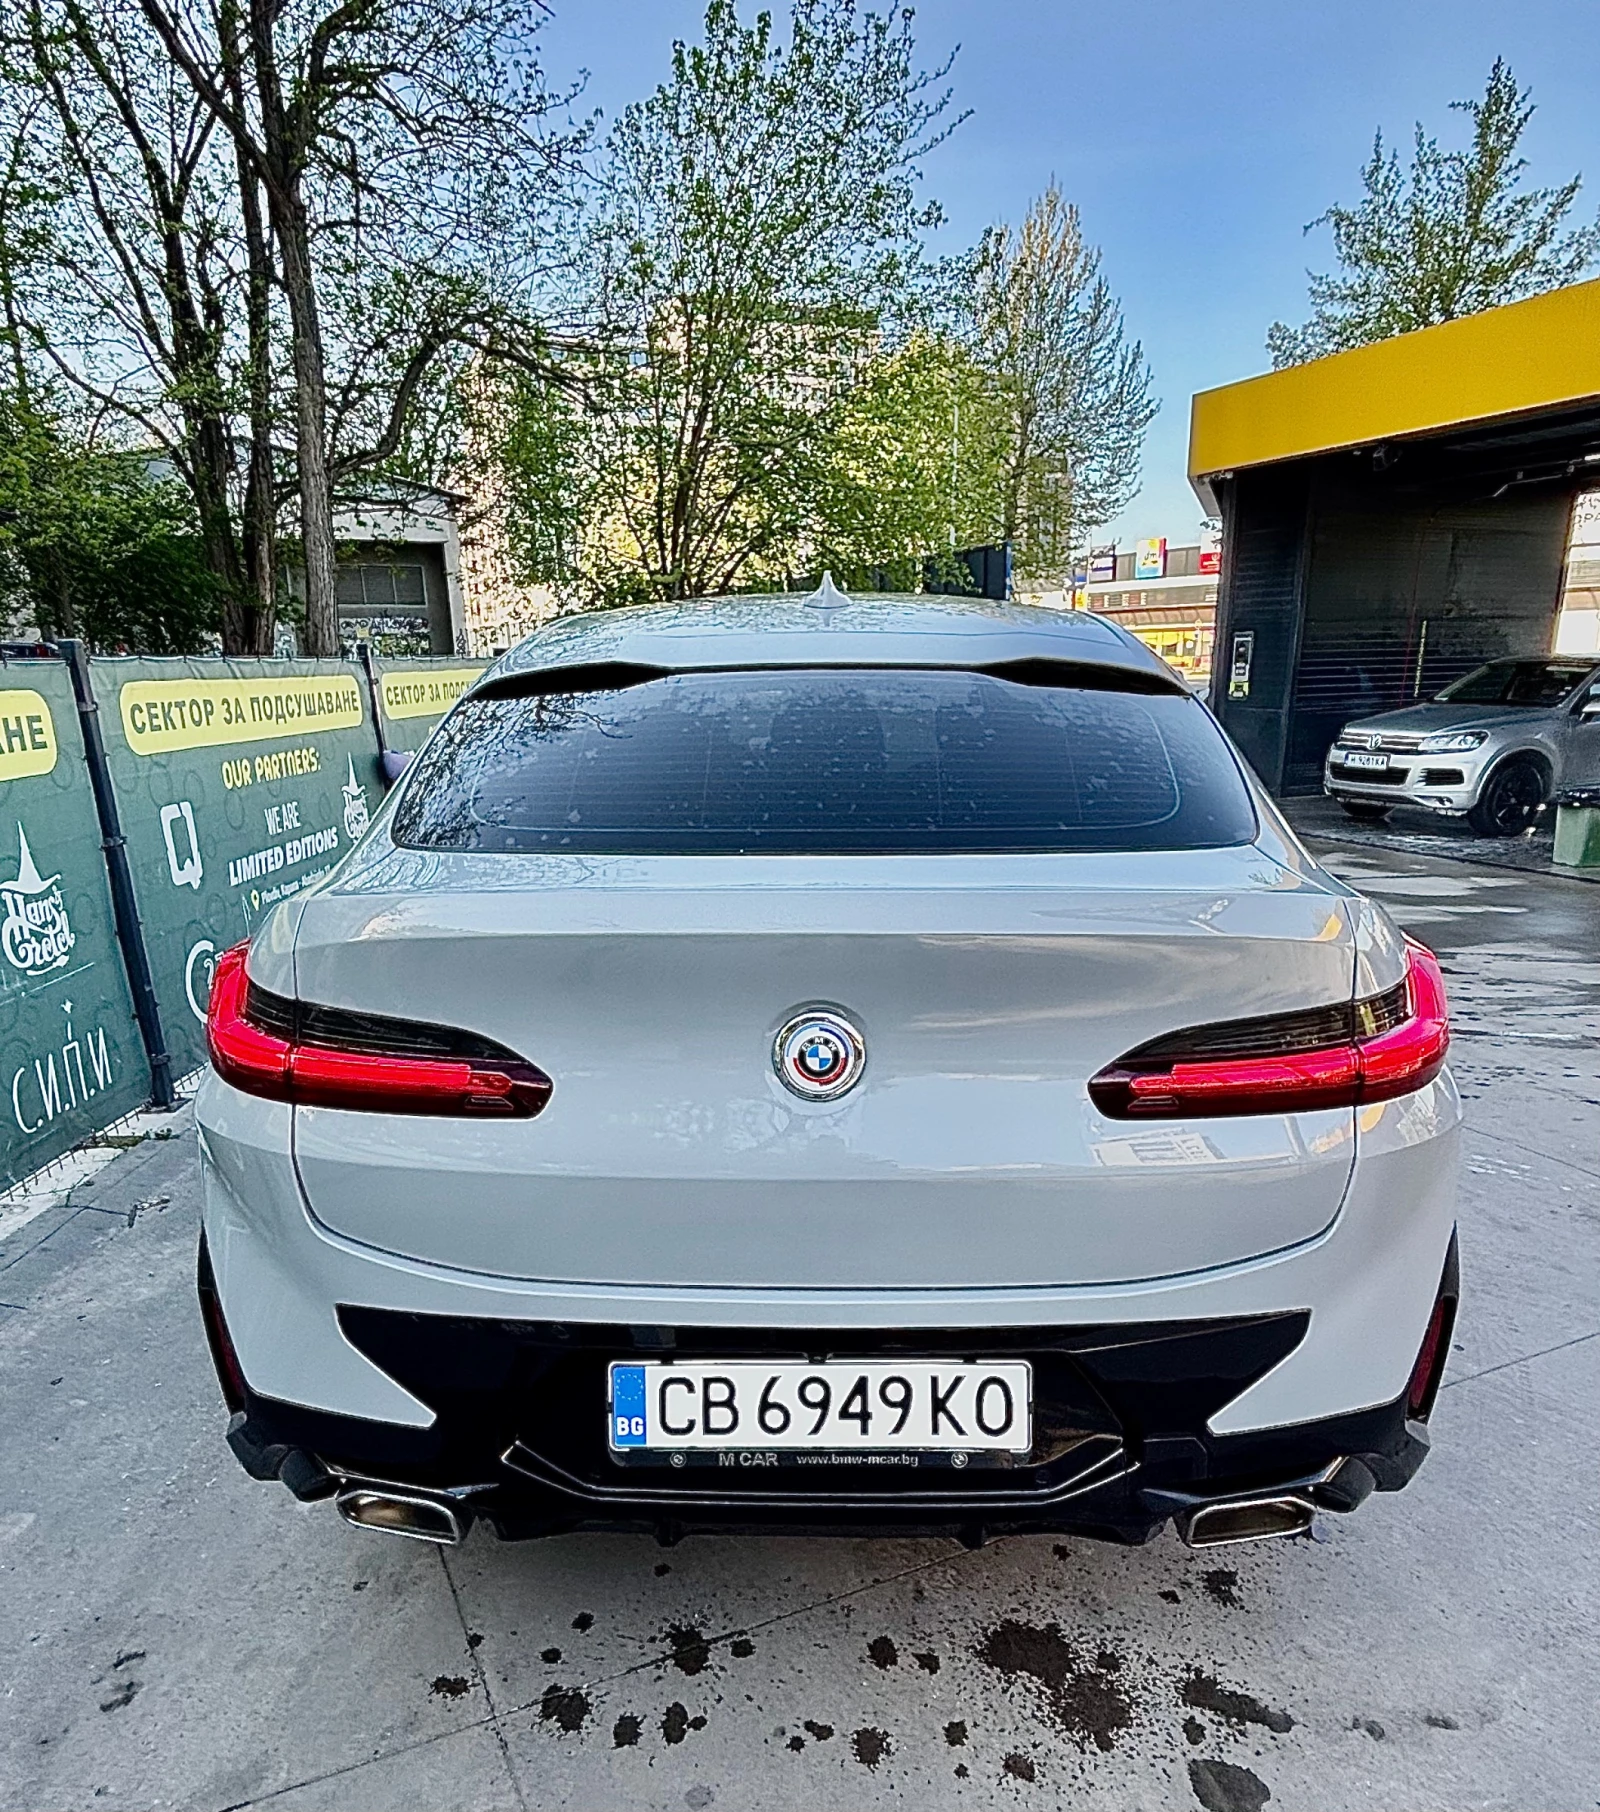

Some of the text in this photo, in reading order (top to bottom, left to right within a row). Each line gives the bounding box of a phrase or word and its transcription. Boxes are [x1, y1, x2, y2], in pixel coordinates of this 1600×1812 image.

[130, 689, 359, 734] СЕКТОР ЗА ПОДСУШАВАНЕ
[386, 684, 426, 706] СЕКТОР
[428, 683, 442, 702] ЗА
[222, 746, 322, 790] OUR PARTNERS:
[264, 801, 301, 836] WE ARE
[228, 846, 284, 887] LIMITED
[285, 826, 339, 866] EDITIONS
[801, 1035, 838, 1052] BMW
[756, 1374, 914, 1437] 6949
[616, 1416, 645, 1437] BG
[739, 1452, 779, 1467] CAR
[796, 1452, 919, 1468] www.bmw-mcar.bg
